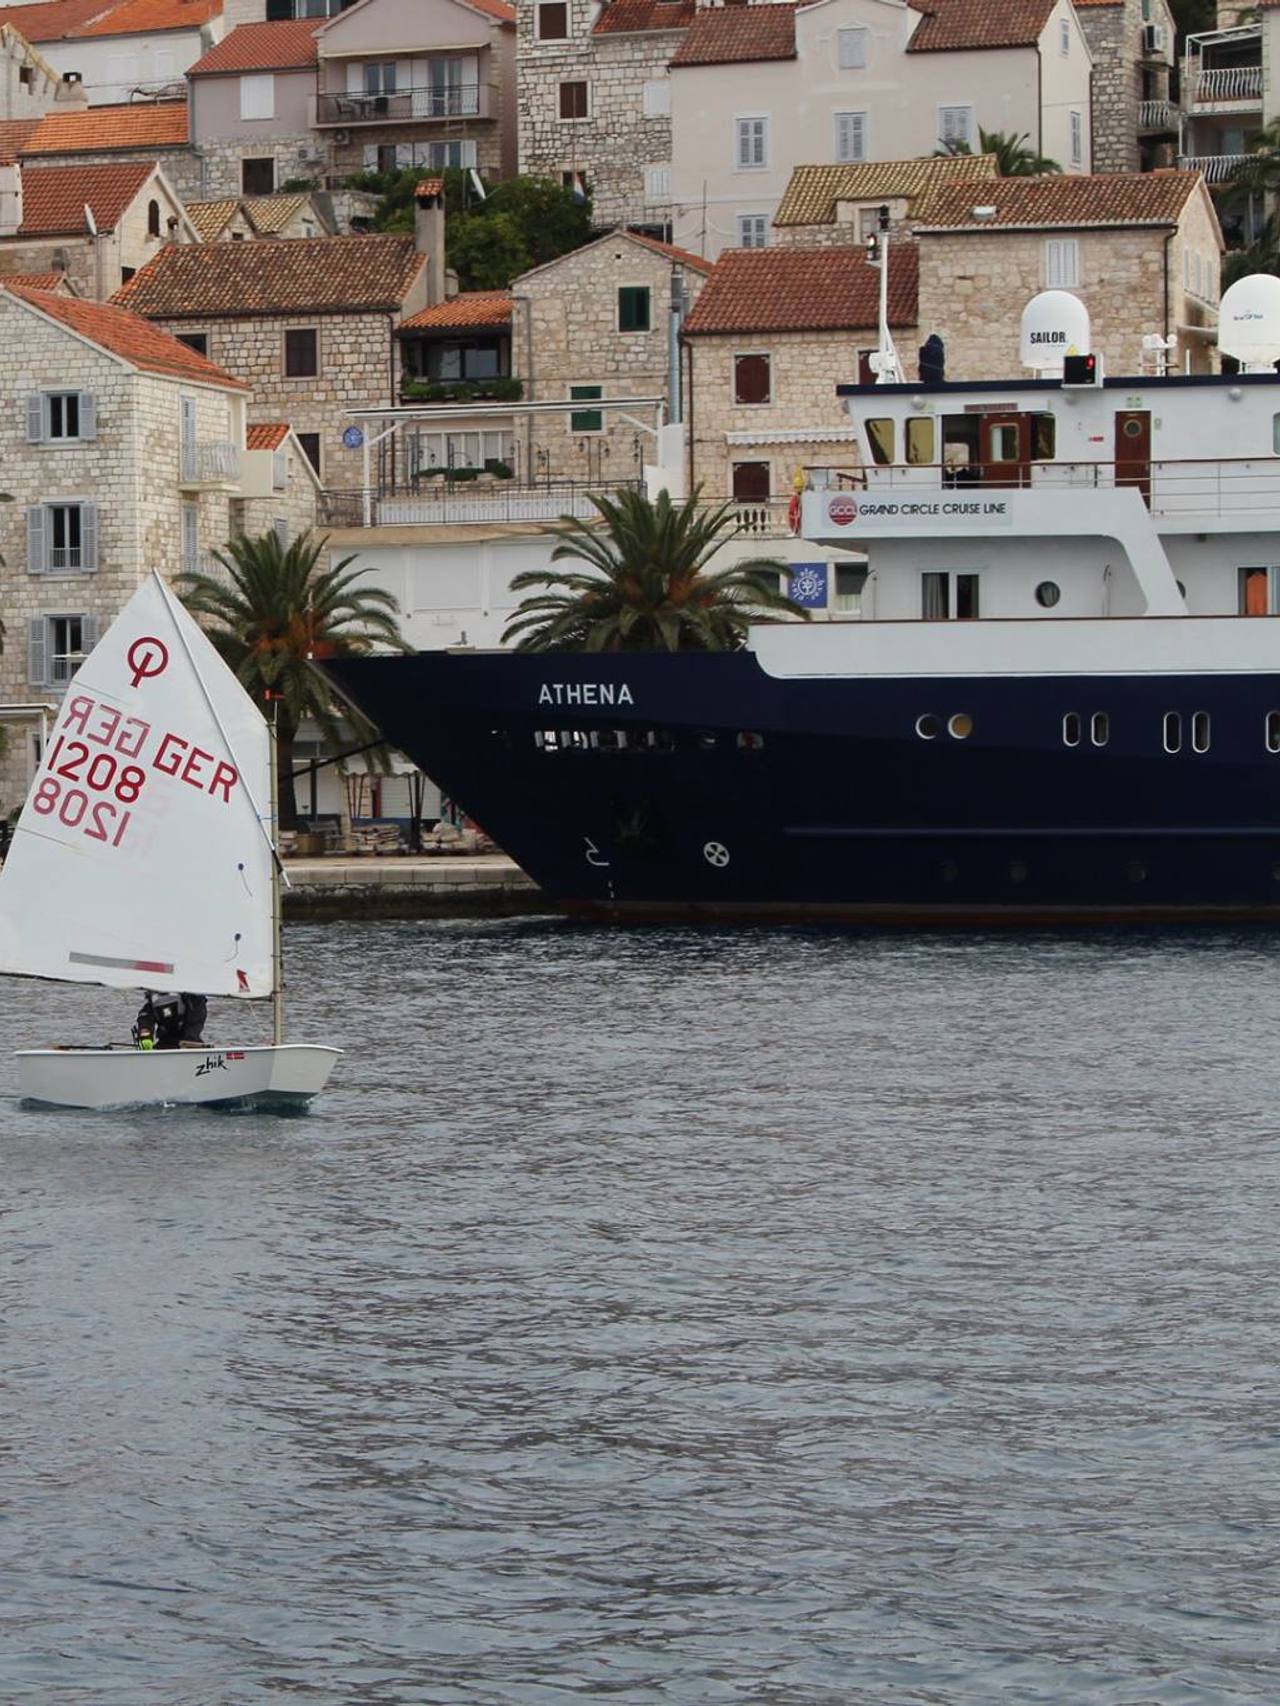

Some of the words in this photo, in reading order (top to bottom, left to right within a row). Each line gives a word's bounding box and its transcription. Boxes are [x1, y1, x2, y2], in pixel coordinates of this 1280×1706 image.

[1030, 331, 1066, 344] SAILOR
[859, 503, 899, 516] GRAND
[900, 503, 940, 516] CIRCLE
[942, 502, 980, 515] CRUISE
[983, 502, 1007, 514] LINE
[538, 683, 634, 705] ATHENA
[47, 735, 146, 804] 1208
[152, 732, 239, 804] GER
[195, 1055, 228, 1077] zhik
